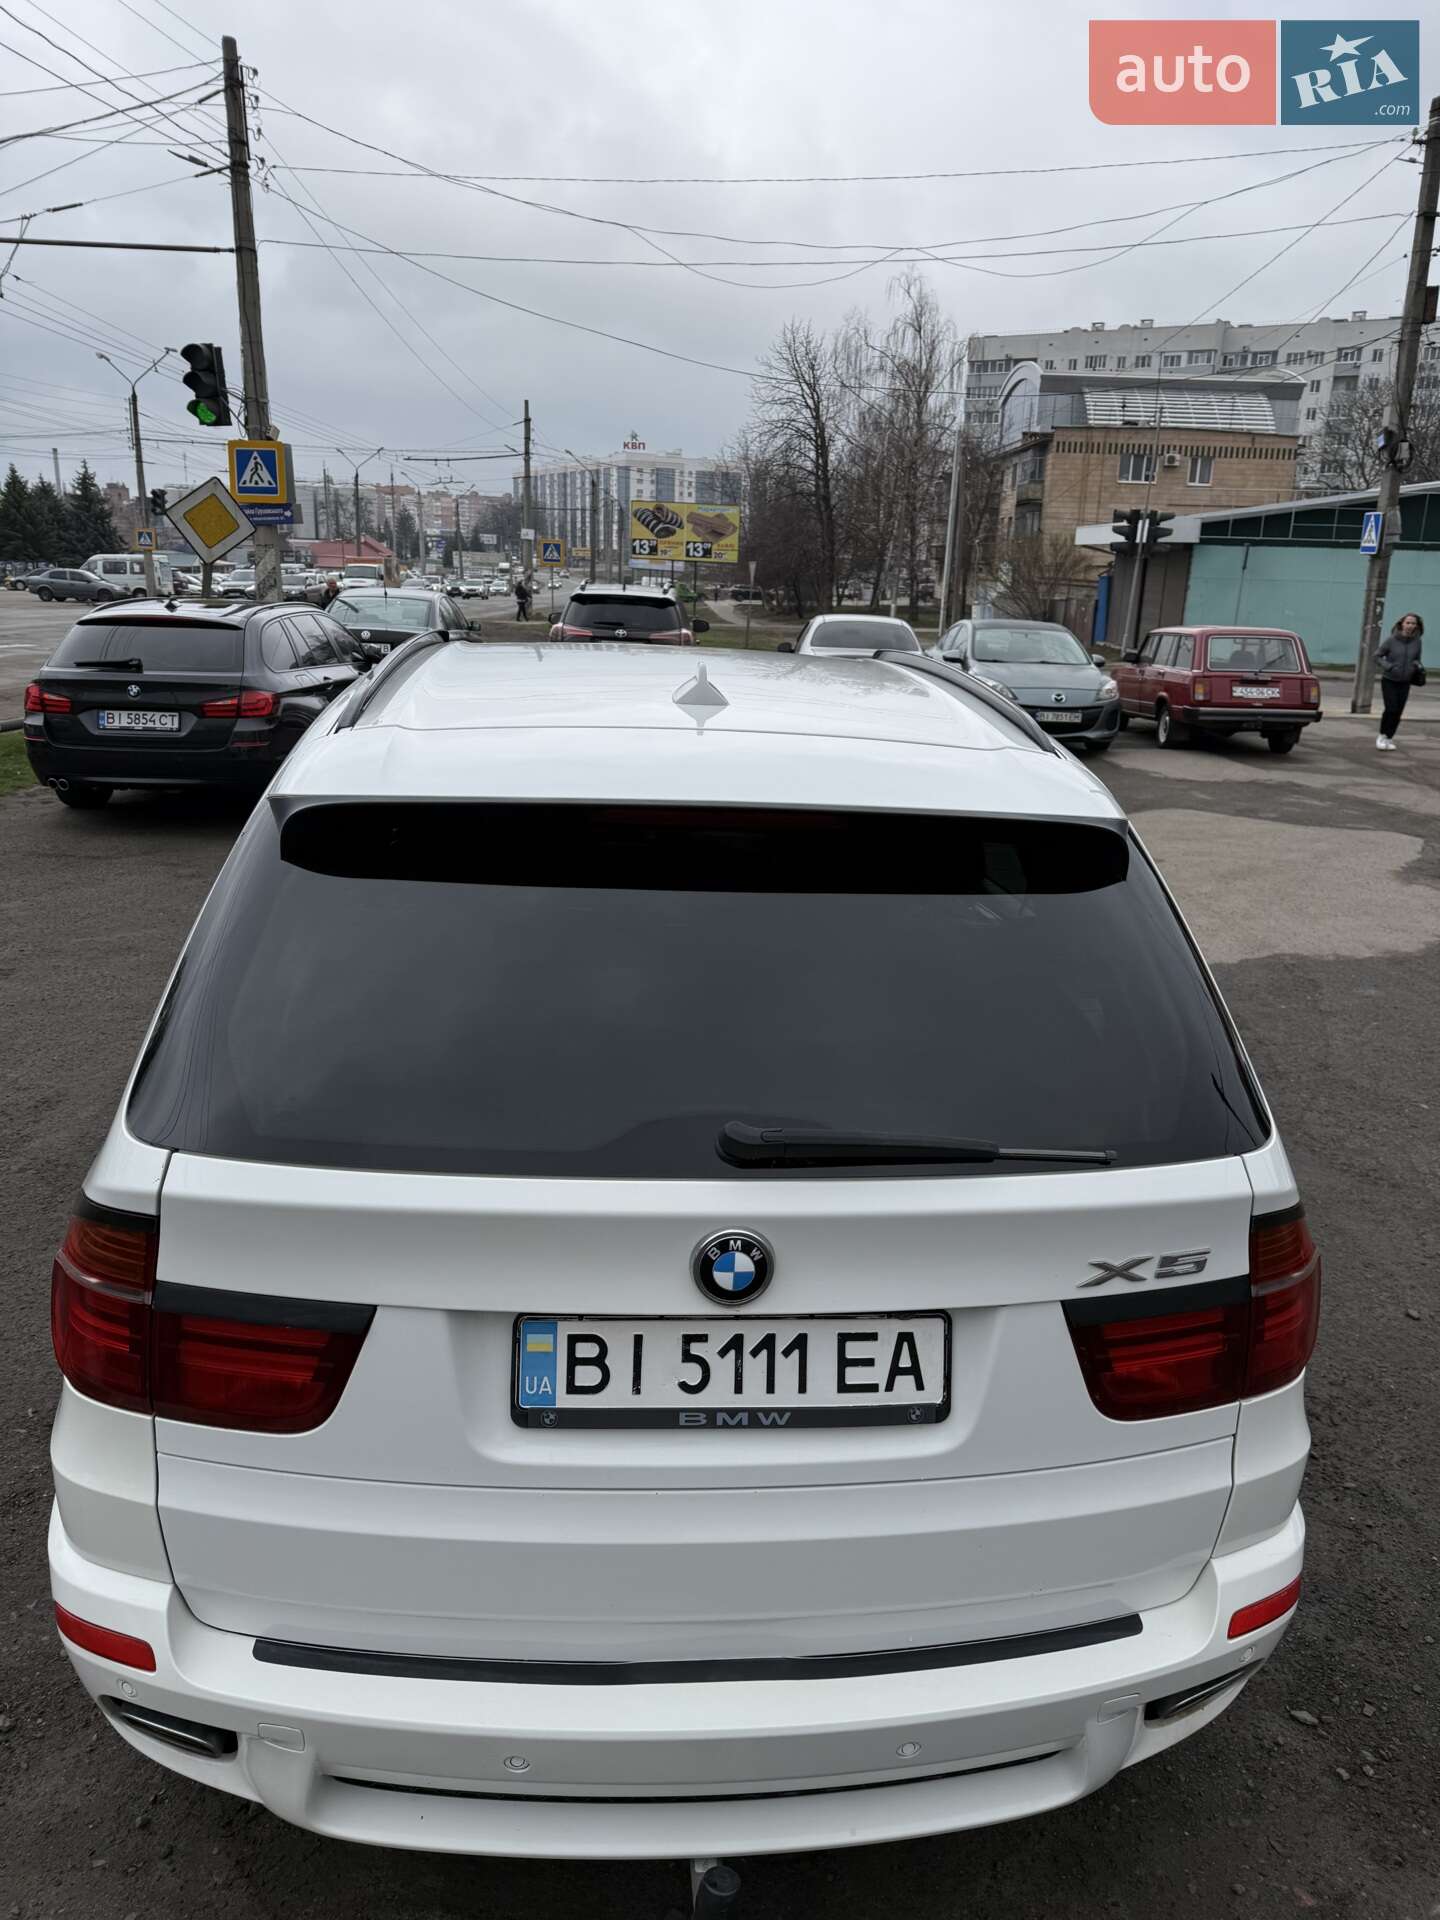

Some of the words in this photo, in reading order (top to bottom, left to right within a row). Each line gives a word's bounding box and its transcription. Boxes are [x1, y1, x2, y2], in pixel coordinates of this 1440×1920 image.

[106, 712, 121, 725] BI
[126, 713, 156, 726] 5854
[159, 714, 177, 726] CT
[707, 1239, 764, 1261] BMW
[1076, 1248, 1211, 1288] X5
[565, 1333, 643, 1396] BI
[676, 1333, 809, 1396] 5111
[837, 1331, 926, 1394] EA
[525, 1375, 553, 1396] UA
[678, 1411, 792, 1427] BMW
